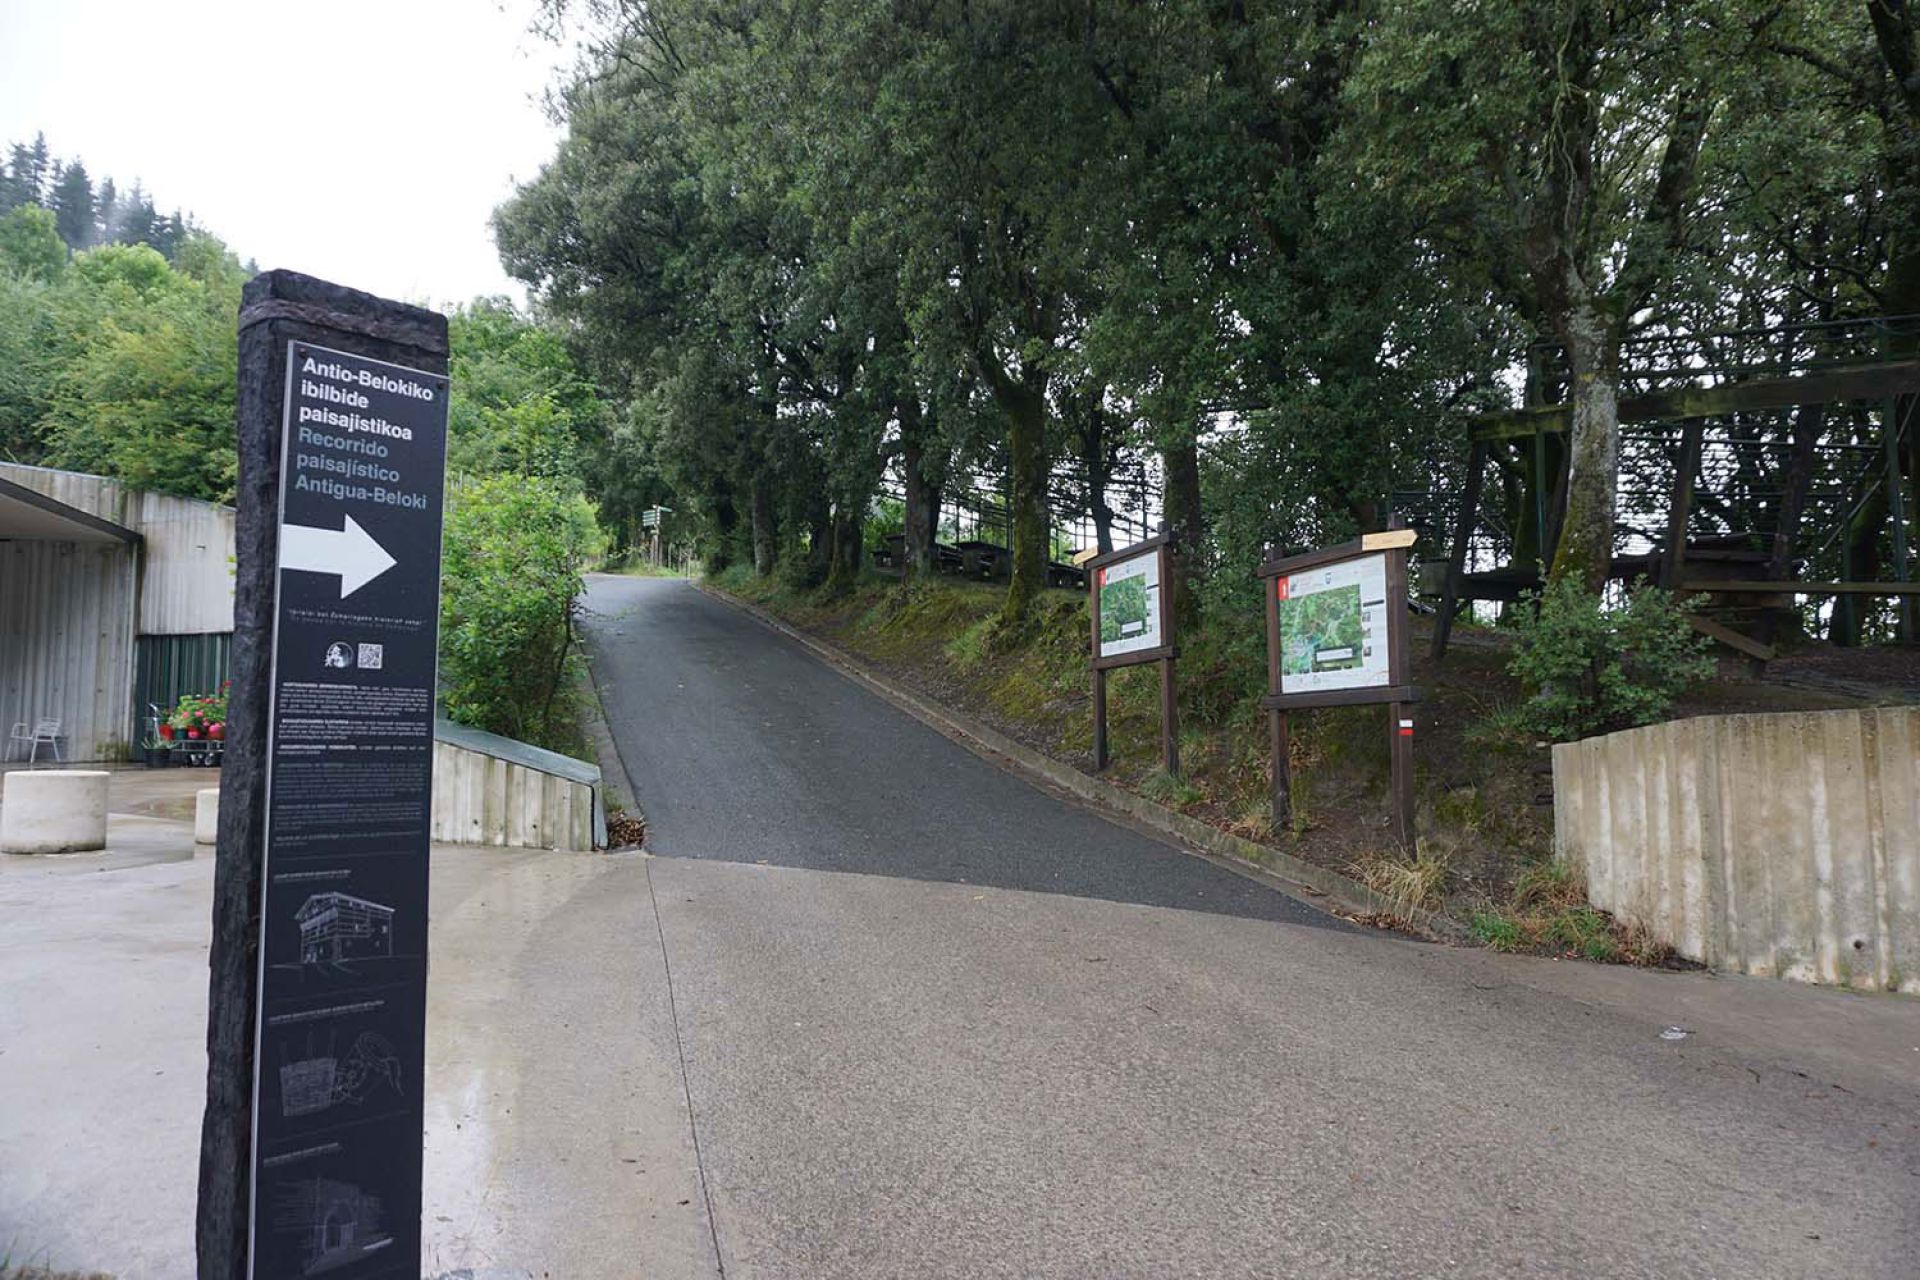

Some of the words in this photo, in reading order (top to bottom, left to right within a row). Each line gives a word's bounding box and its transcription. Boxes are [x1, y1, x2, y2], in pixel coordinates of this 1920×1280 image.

[301, 379, 369, 409] ibilbide
[302, 357, 433, 401] Antio-Belokiko
[299, 406, 412, 440] paisajistikoa
[298, 427, 389, 458] Recorrido
[296, 454, 400, 482] paisajístico
[295, 474, 427, 509] Antigua-Beloki
